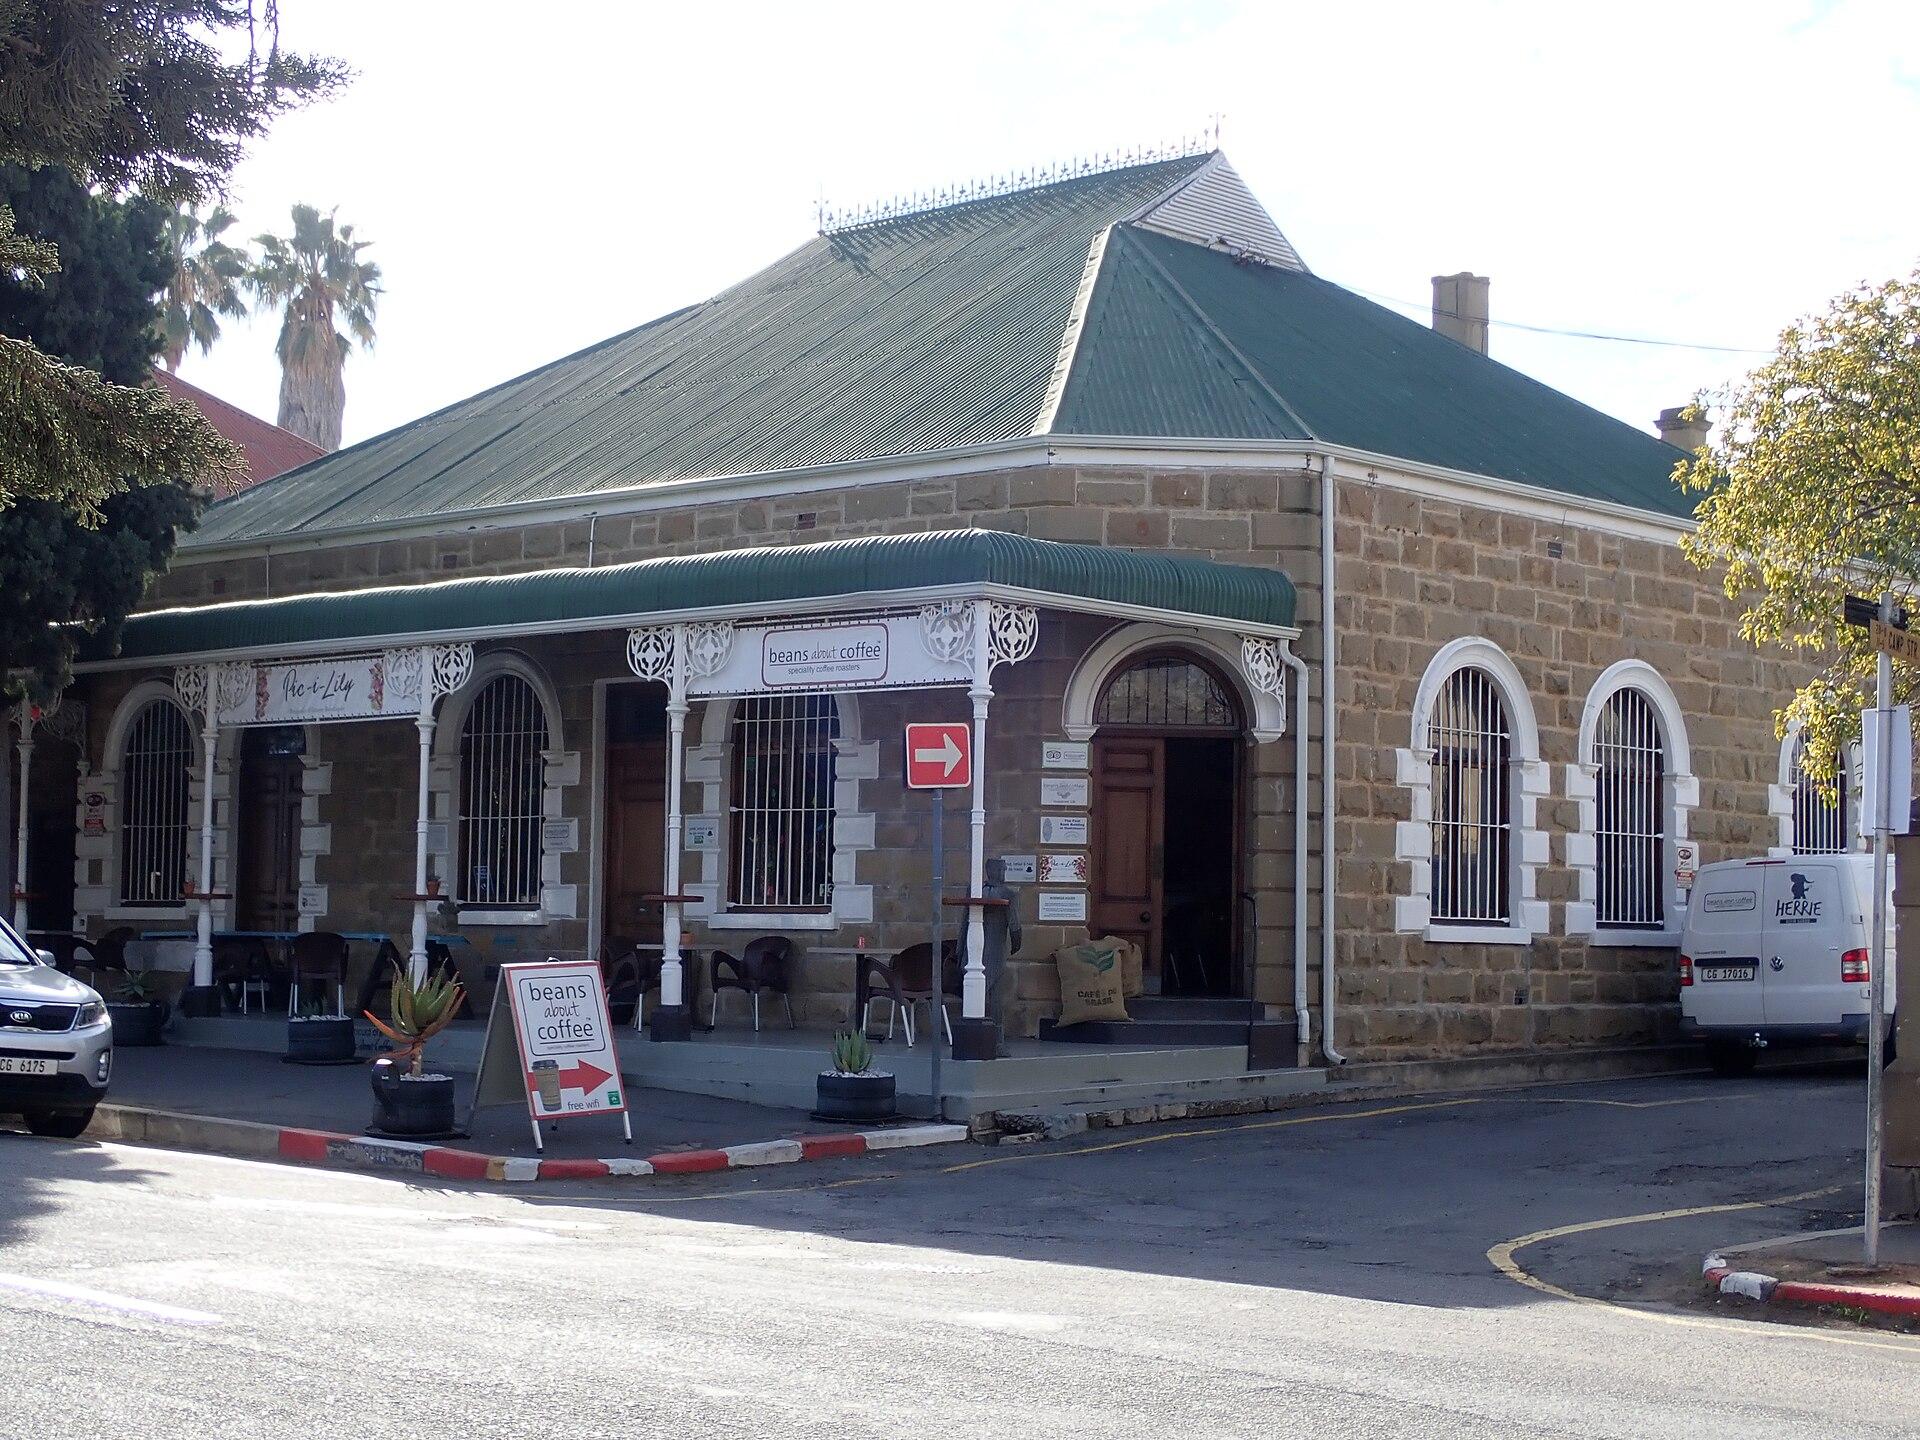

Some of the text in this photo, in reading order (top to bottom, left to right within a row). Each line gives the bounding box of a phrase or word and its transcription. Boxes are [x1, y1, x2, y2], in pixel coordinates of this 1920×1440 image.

[769, 641, 881, 663] beans about coffee
[816, 664, 834, 673] coffee
[835, 663, 861, 672] roasters
[282, 668, 355, 702] Pic-i-Lily
[1775, 899, 1822, 917] HERRIE
[1706, 968, 1749, 979] CG 17016
[528, 982, 587, 1001] beans
[544, 999, 580, 1018] about
[537, 1019, 594, 1040] coffee
[0, 1058, 46, 1073] CG 6175
[567, 1100, 584, 1111] free
